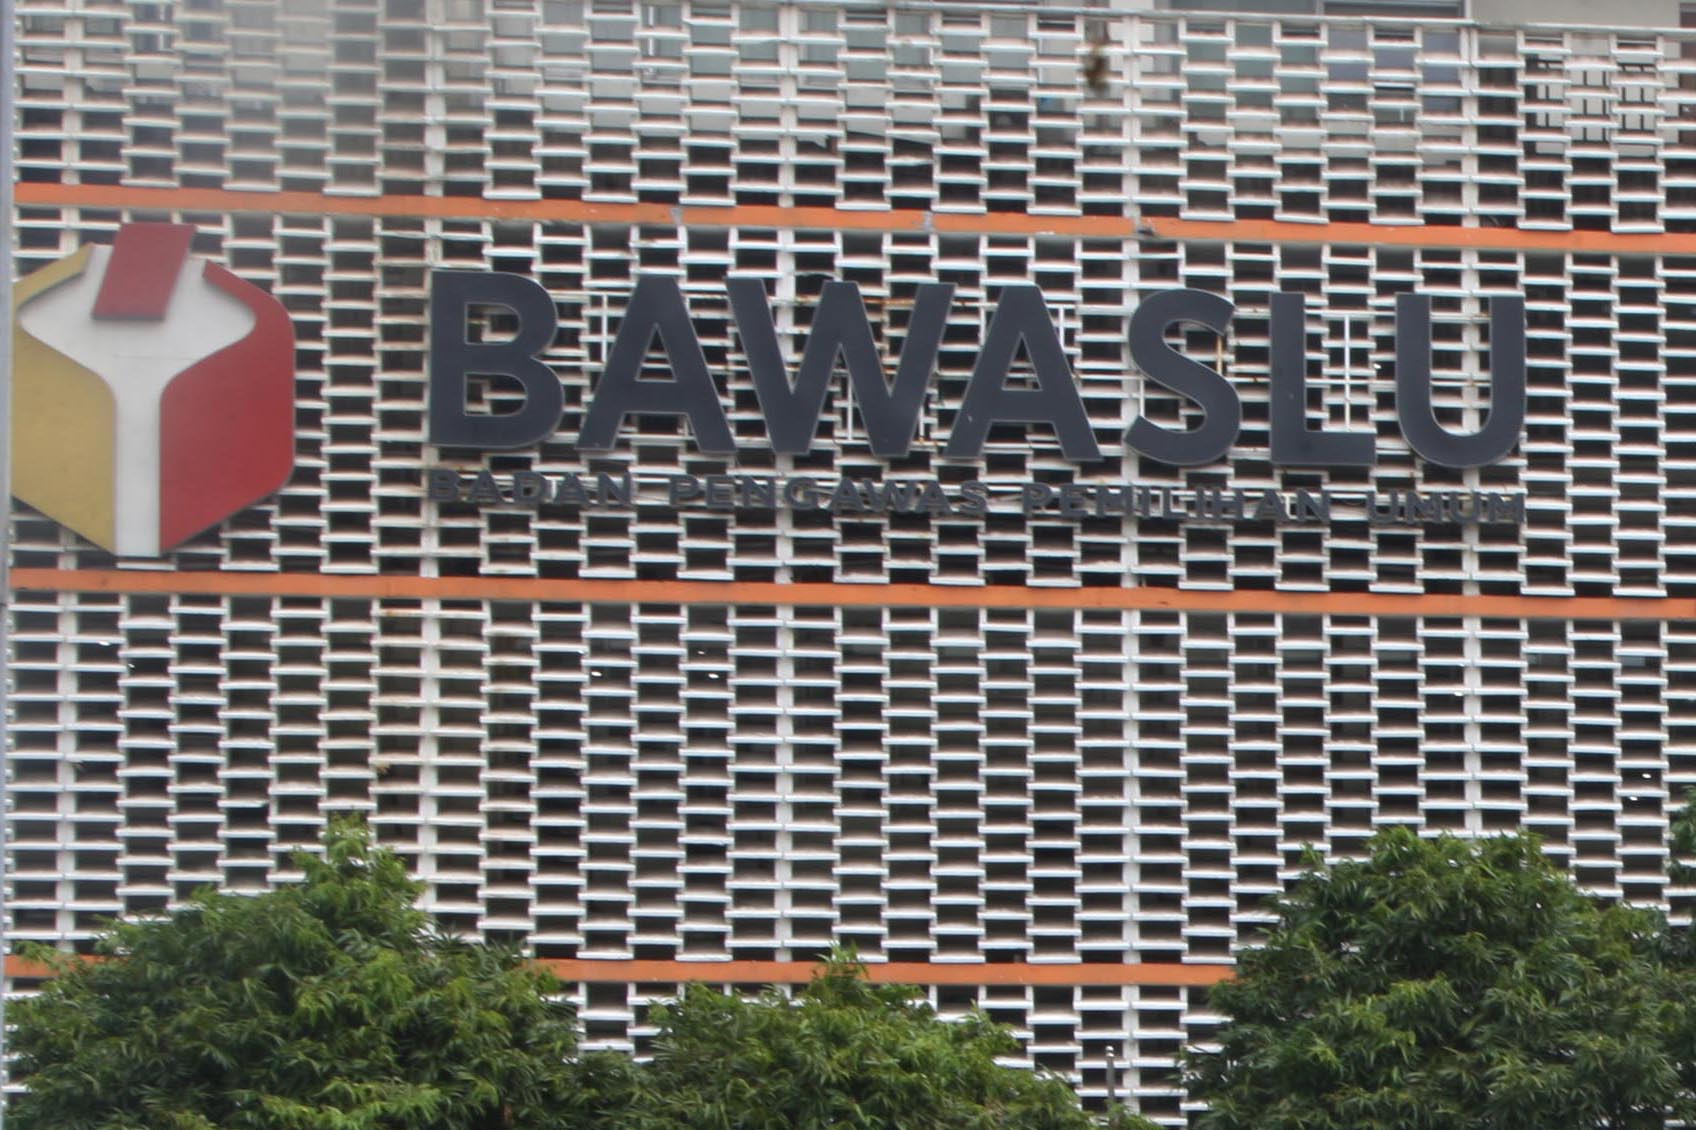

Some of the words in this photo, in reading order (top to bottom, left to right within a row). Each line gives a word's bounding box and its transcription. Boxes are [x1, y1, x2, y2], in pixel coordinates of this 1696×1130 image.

[430, 270, 1526, 467] BAWASLU
[428, 469, 634, 507] BADAN
[668, 473, 989, 517] PENGAWAS
[1022, 482, 1332, 524] PEMILIHAN
[1366, 489, 1526, 526] UMUM
